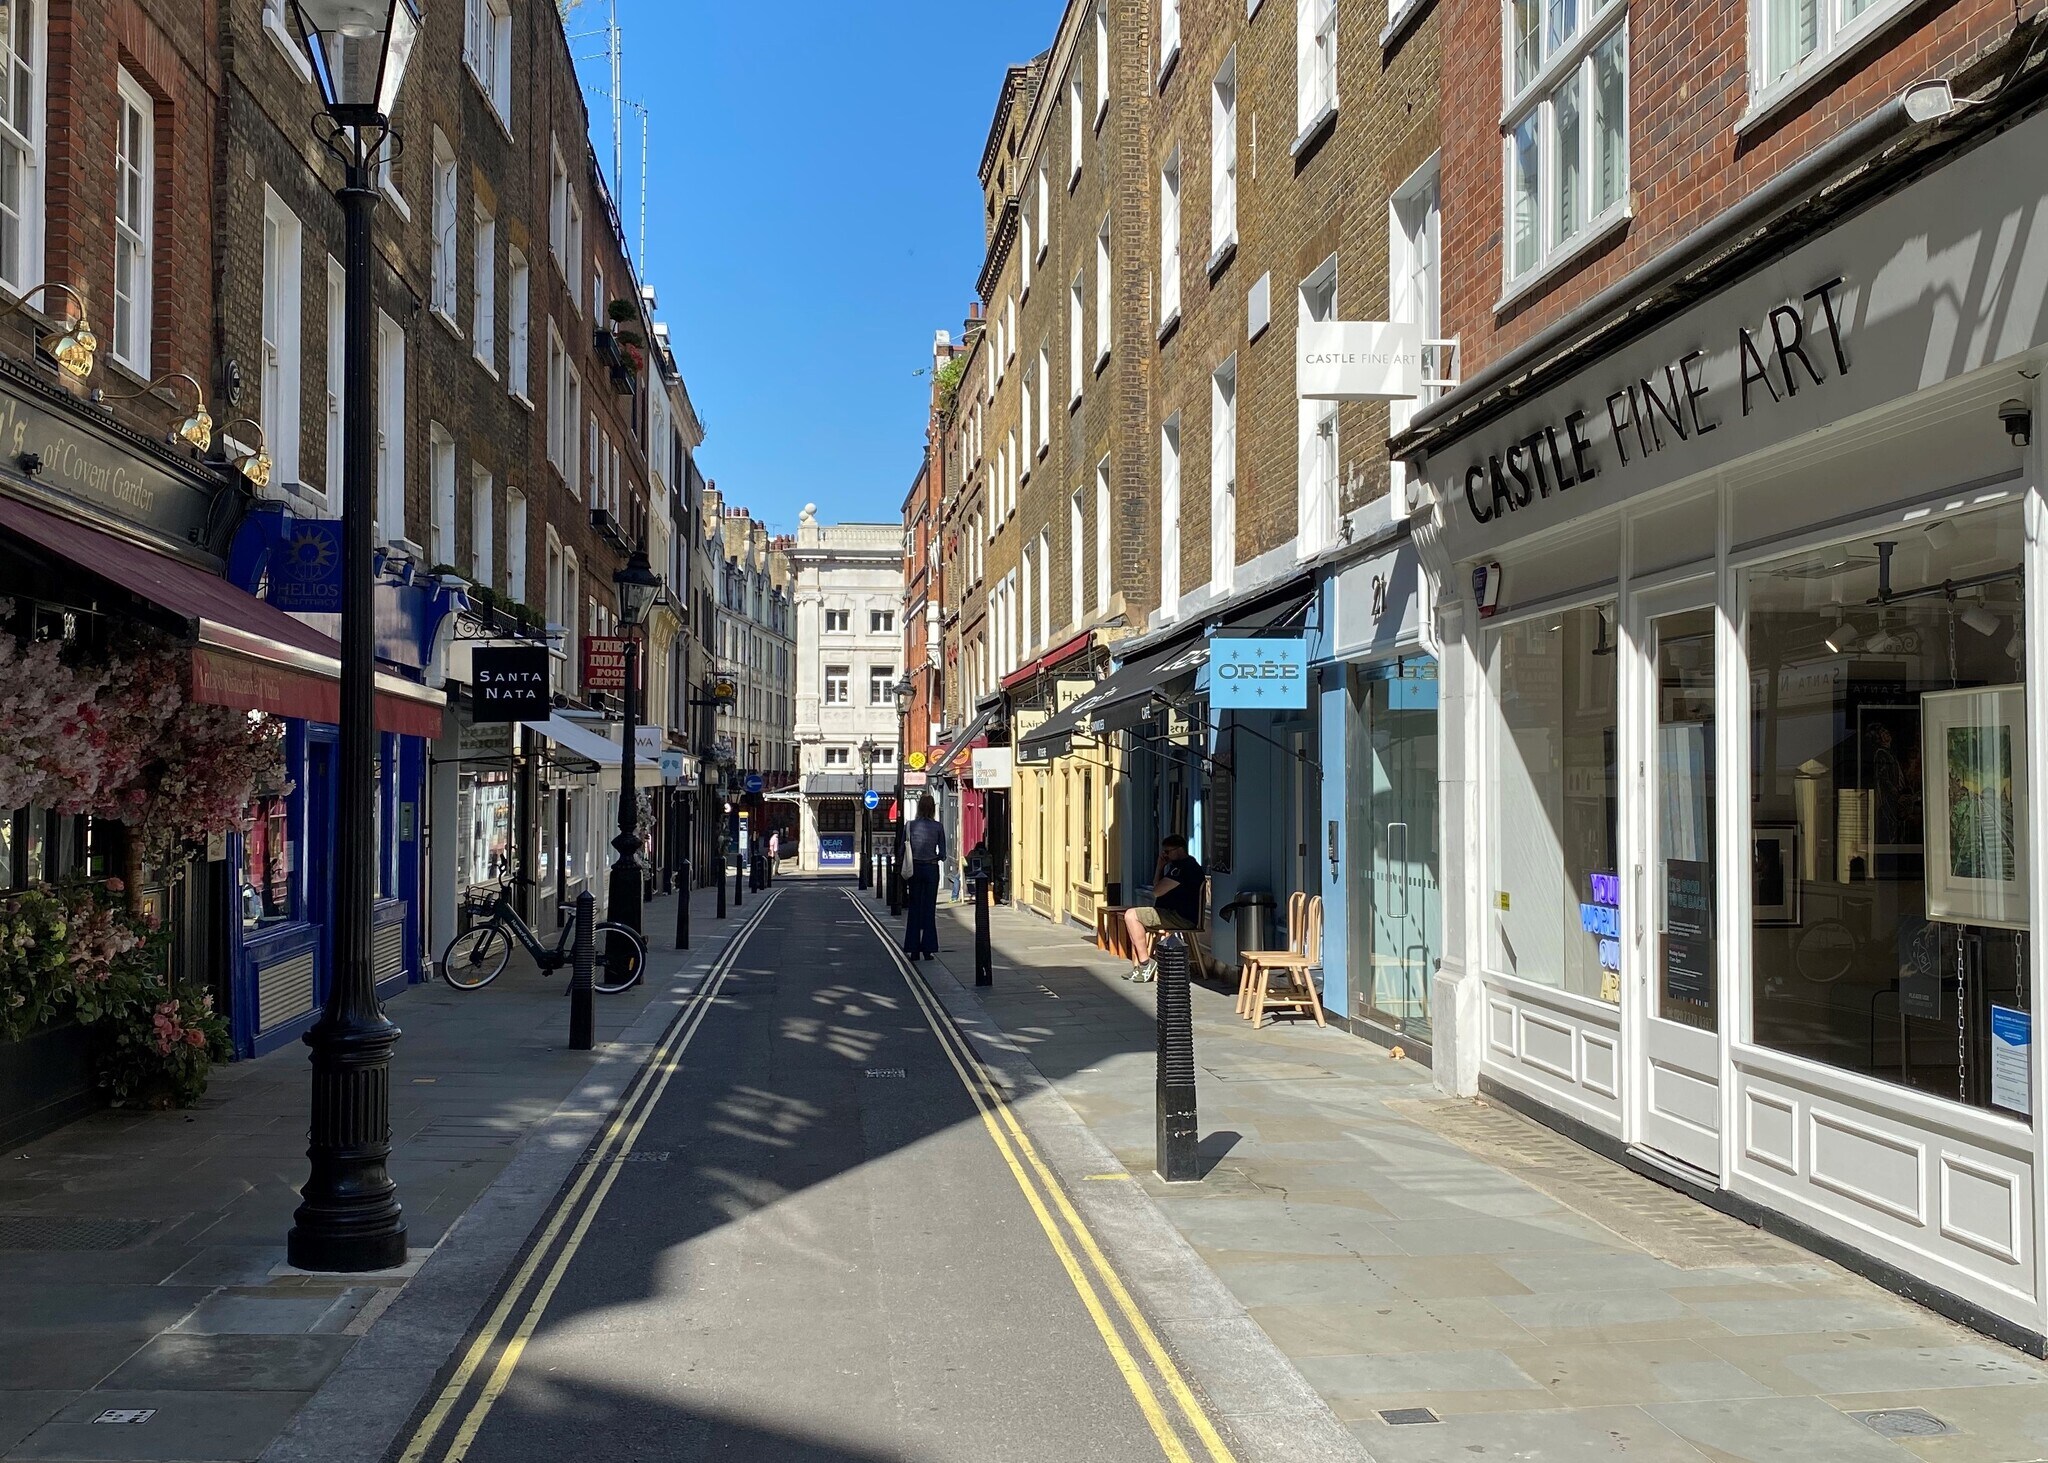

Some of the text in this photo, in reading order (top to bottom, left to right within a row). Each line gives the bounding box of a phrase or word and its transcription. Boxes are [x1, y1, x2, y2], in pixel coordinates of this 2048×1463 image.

[1305, 353, 1417, 365] CASTLE FINE ART
[1465, 277, 1849, 525] CASTLE FINE ART
[43, 438, 65, 471] of
[62, 443, 111, 493] Covent
[112, 467, 154, 512] Garden
[278, 583, 339, 597] HELIOS
[1371, 571, 1387, 616] 21
[590, 654, 626, 667] INDIA
[479, 670, 542, 682] SANTA
[486, 687, 536, 699] NATA
